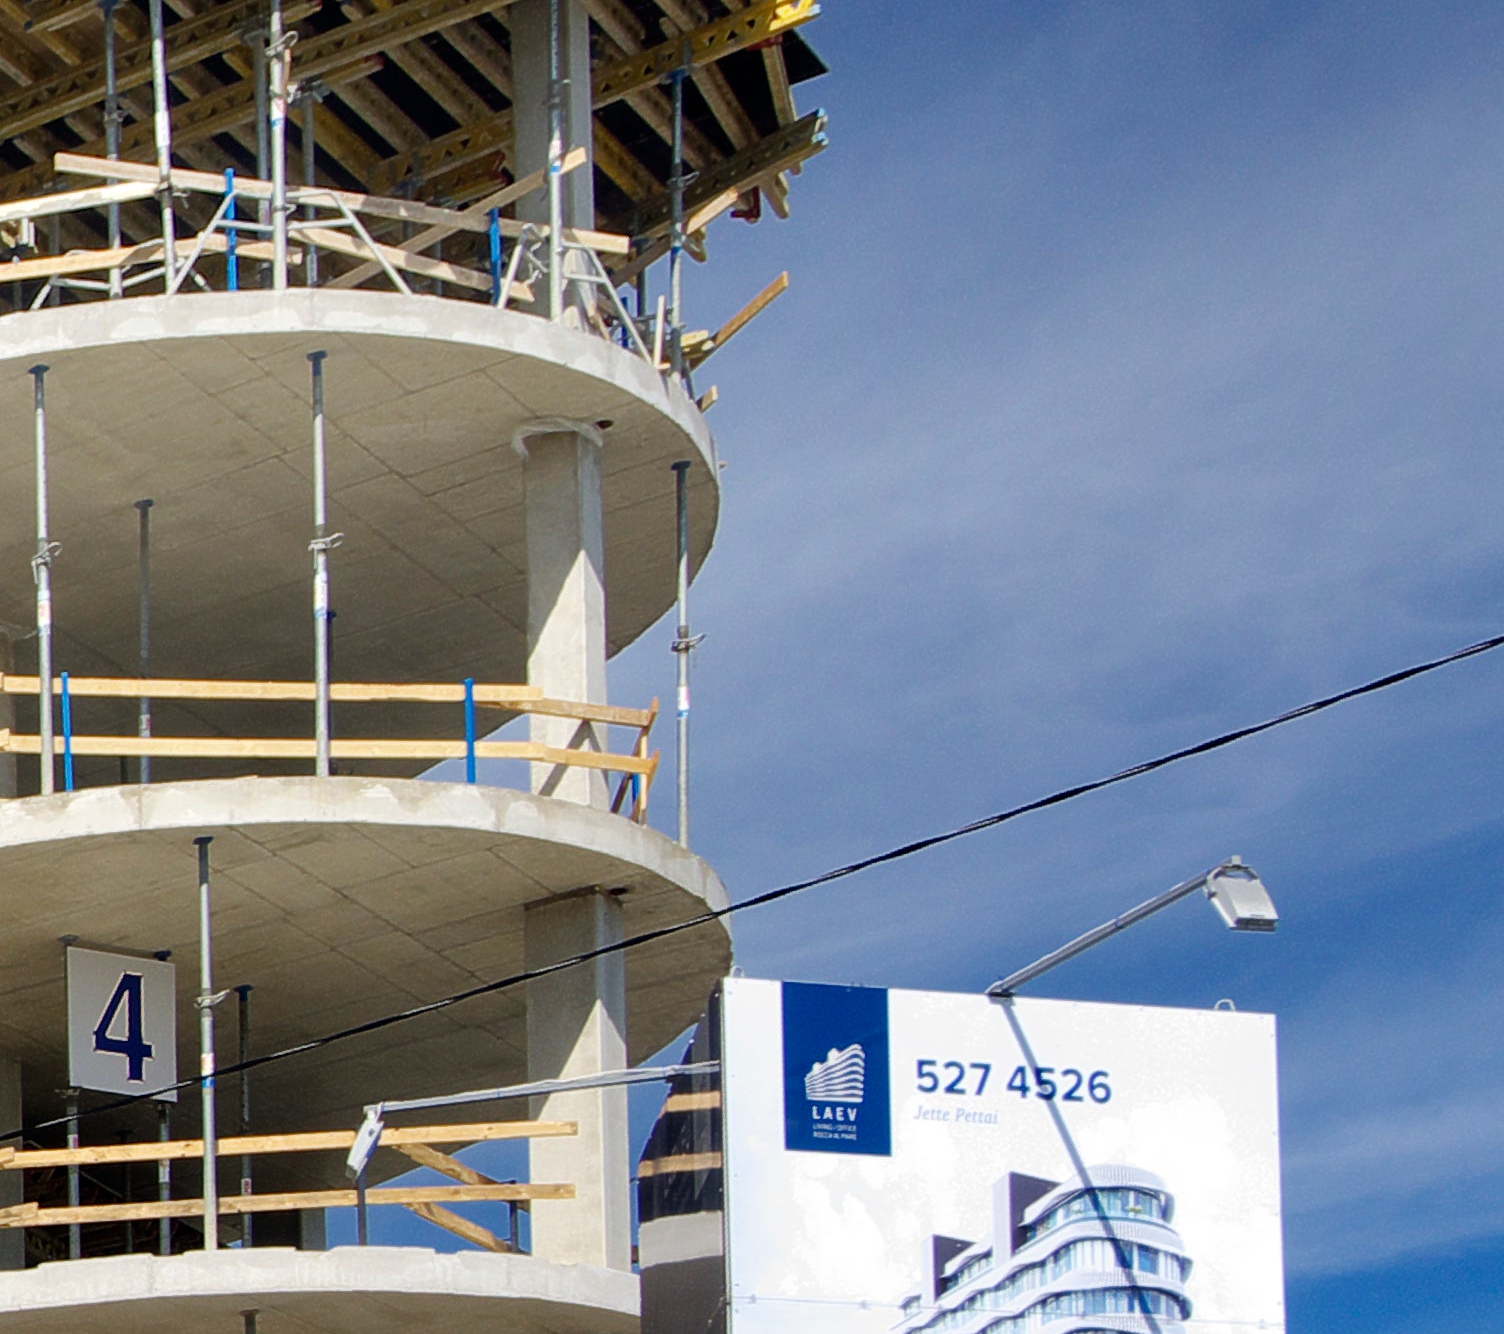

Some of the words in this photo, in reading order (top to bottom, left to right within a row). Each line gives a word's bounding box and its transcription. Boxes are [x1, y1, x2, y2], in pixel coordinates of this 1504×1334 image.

[93, 971, 155, 1084] 4
[916, 1059, 992, 1097] 527
[1006, 1065, 1112, 1104] 4526
[812, 1105, 857, 1121] LAEV
[913, 1105, 951, 1123] Jette
[955, 1106, 1000, 1125] Pettai
